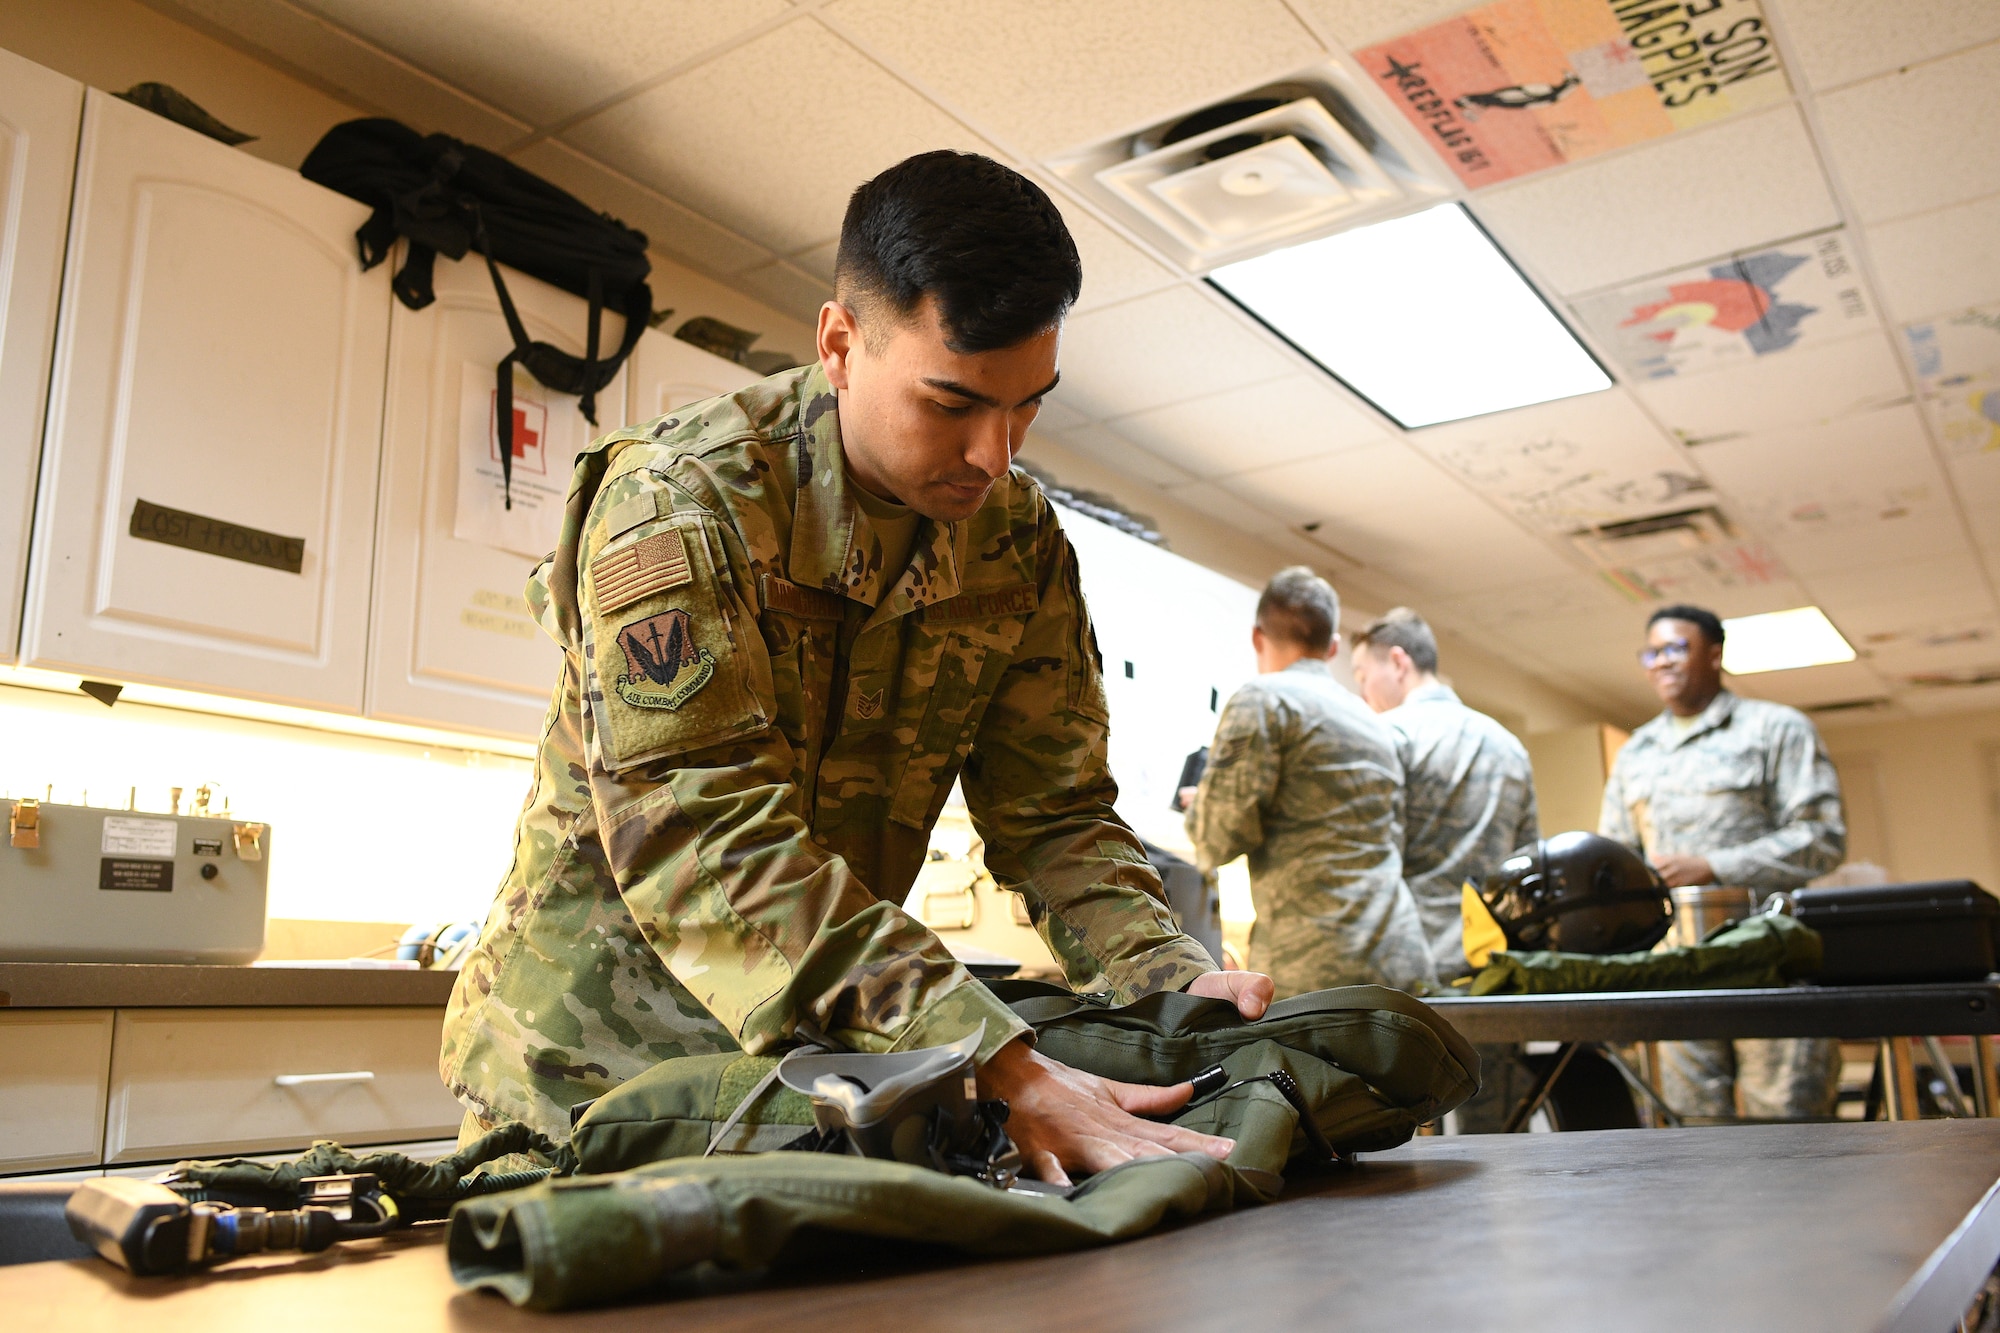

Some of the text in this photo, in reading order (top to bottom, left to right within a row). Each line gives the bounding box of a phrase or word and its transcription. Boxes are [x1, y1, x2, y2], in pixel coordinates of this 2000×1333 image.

[1609, 0, 1718, 107] AGPIES
[136, 506, 195, 539] LOST
[977, 585, 1034, 615] FORCE
[626, 664, 711, 708] AIR COMBAT COMMAND
